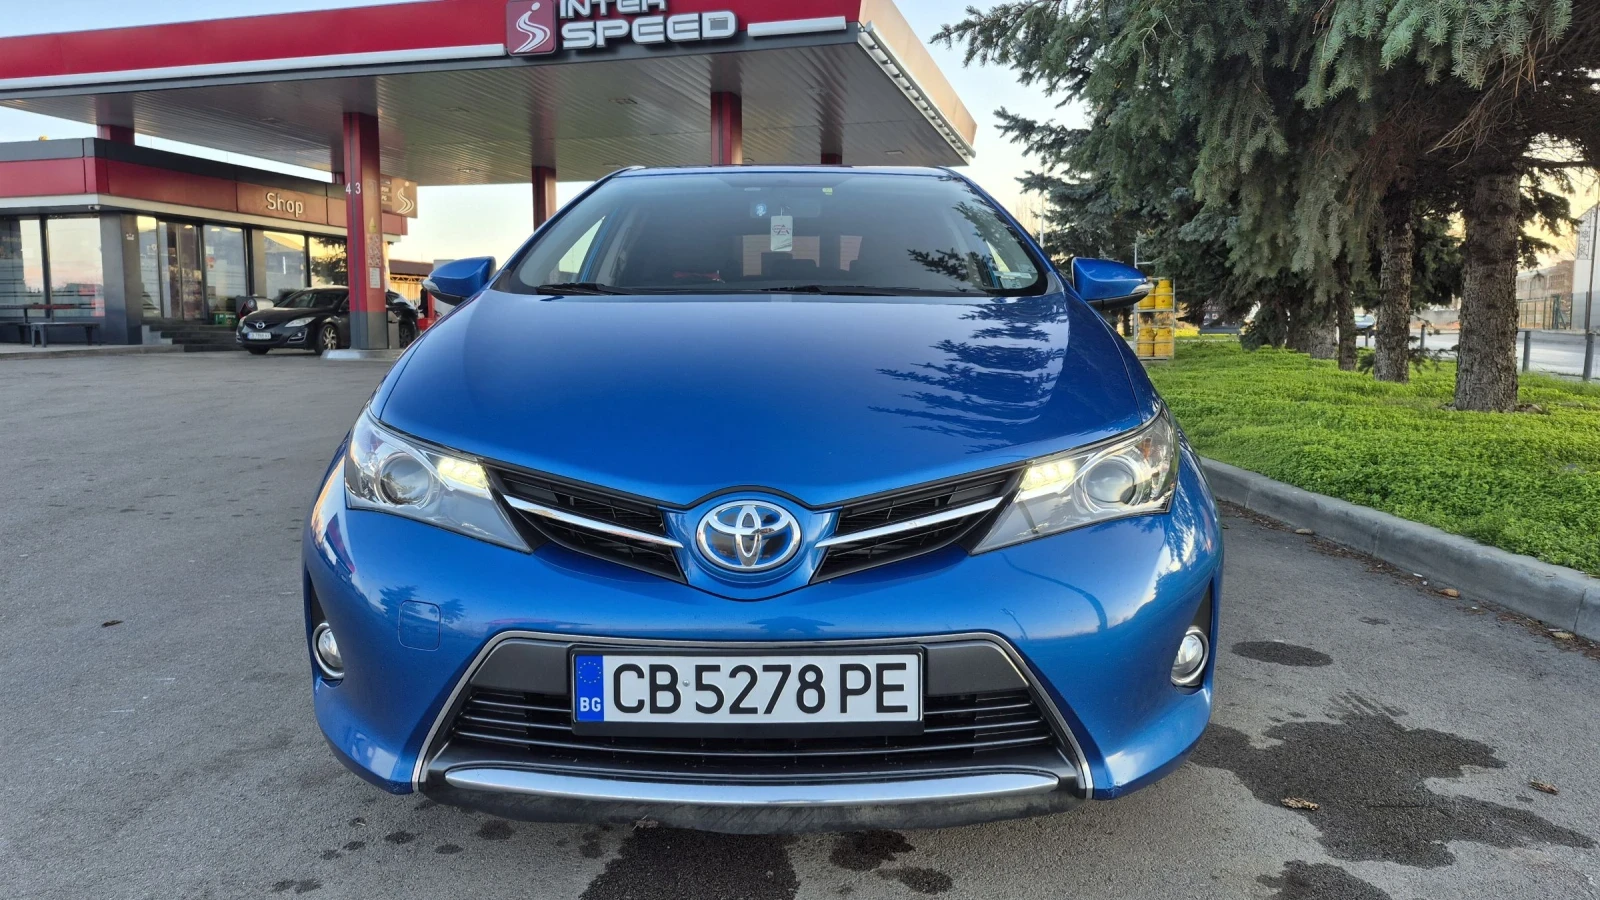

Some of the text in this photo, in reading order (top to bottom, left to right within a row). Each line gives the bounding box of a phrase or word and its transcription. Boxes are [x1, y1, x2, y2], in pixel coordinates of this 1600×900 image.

[561, 11, 737, 50] SPEED
[345, 182, 361, 195] 4 3
[266, 192, 303, 218] Shop
[612, 662, 908, 715] CB 5278 PE
[579, 696, 601, 712] BG
